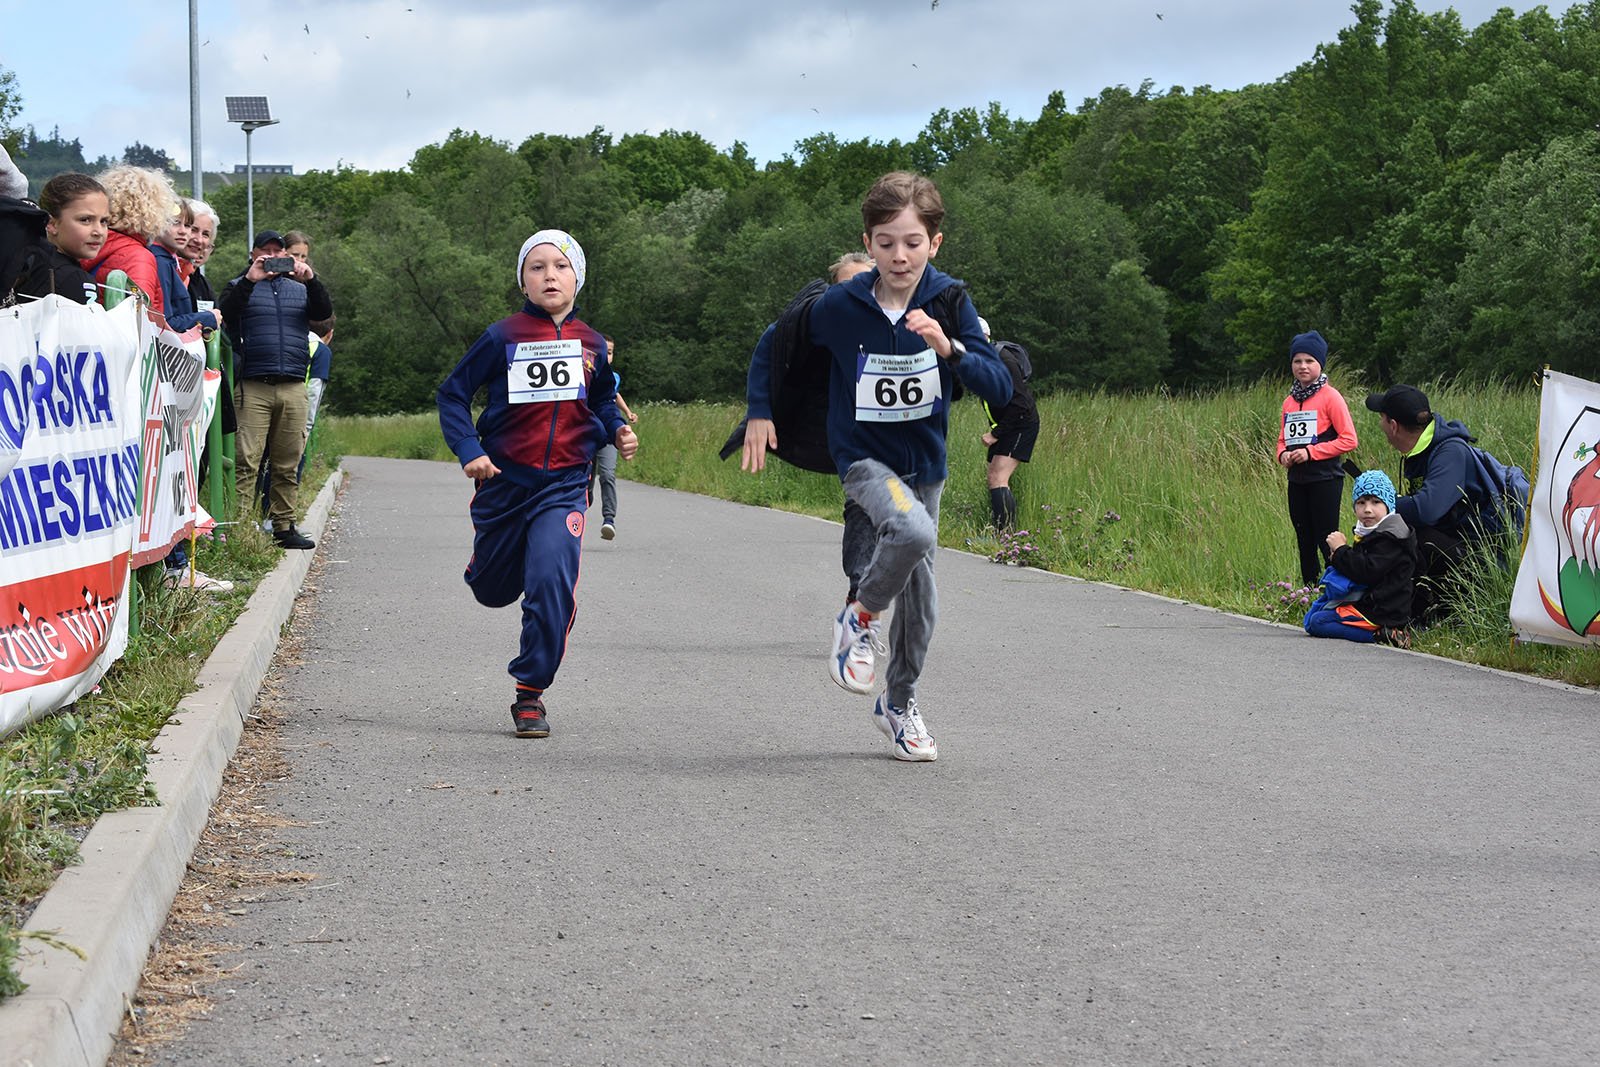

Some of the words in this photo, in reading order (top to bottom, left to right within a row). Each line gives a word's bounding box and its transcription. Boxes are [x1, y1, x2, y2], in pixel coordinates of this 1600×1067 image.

[526, 360, 571, 389] 96
[874, 376, 924, 407] 66
[1289, 421, 1307, 438] 93
